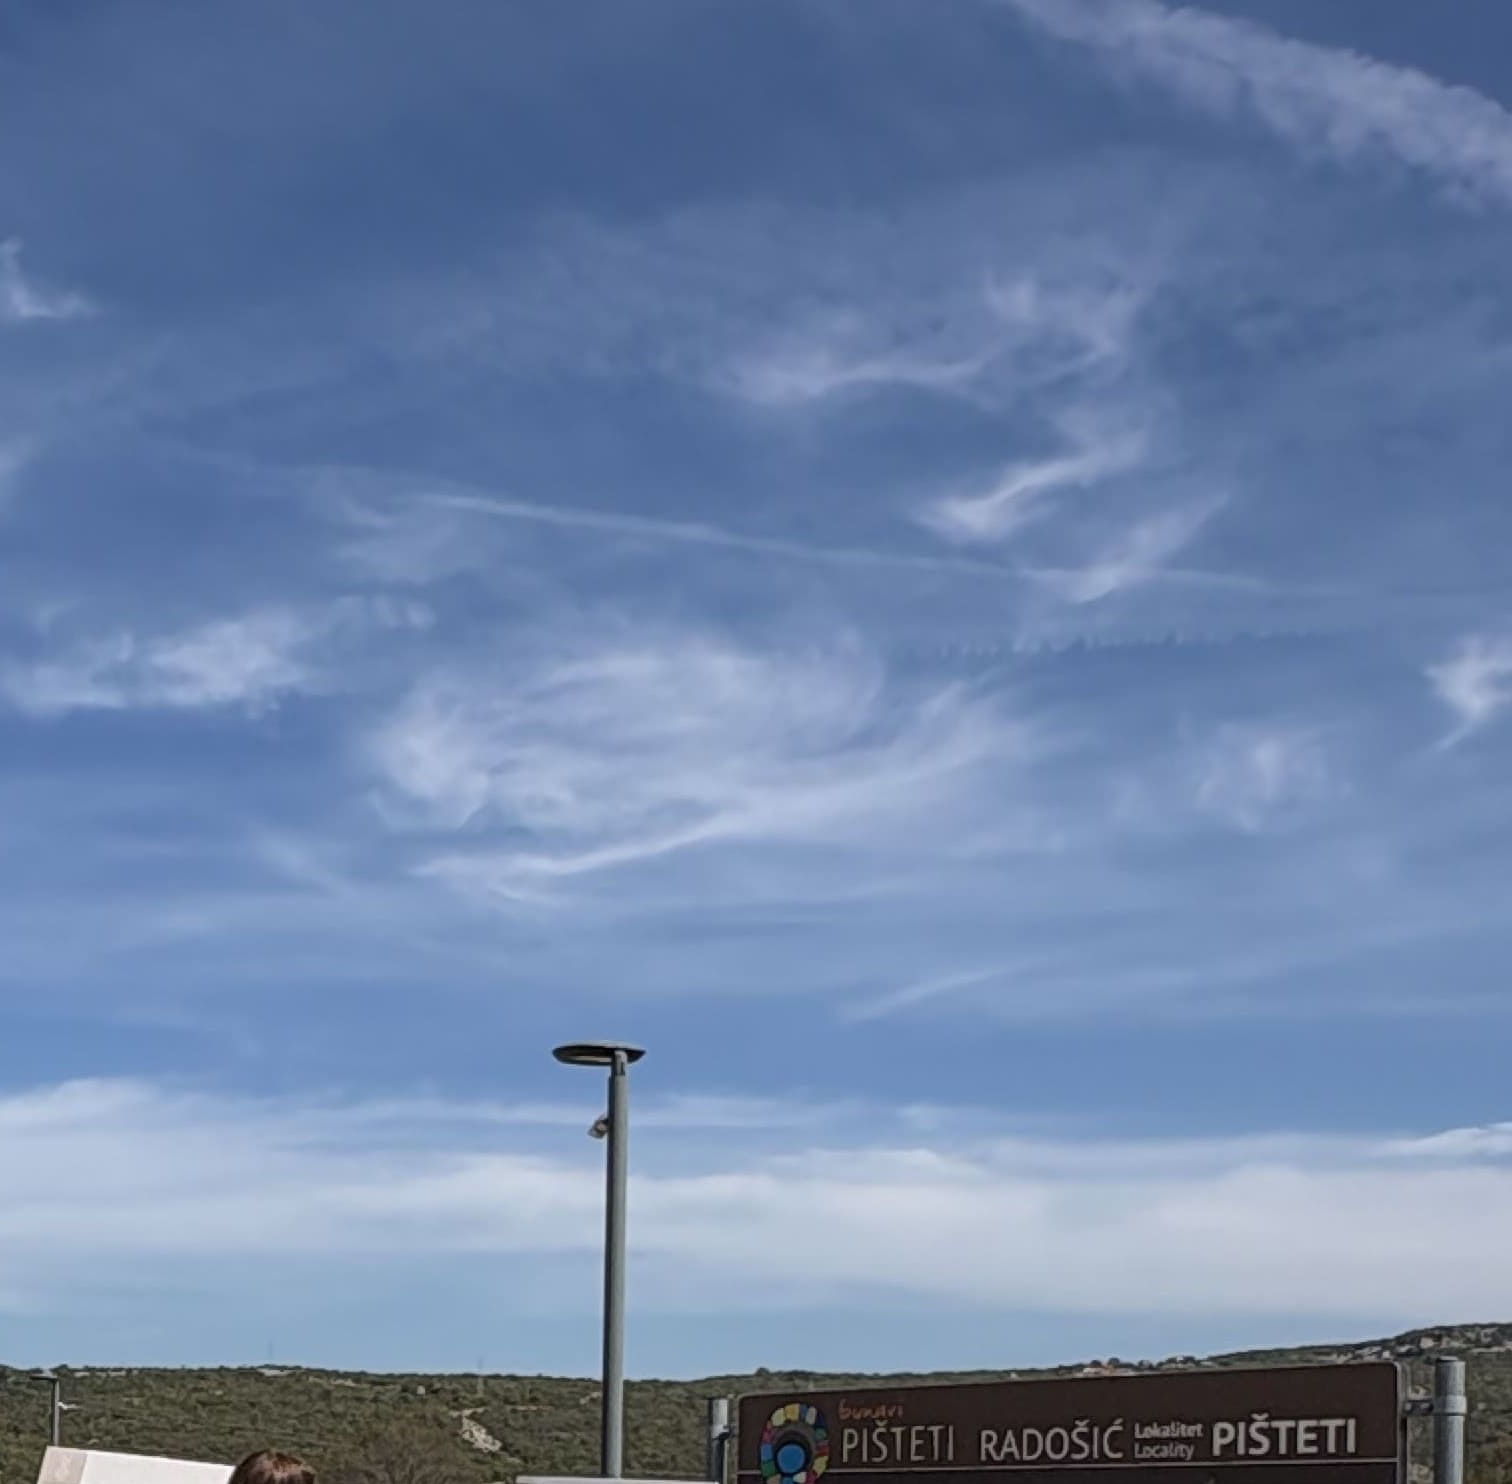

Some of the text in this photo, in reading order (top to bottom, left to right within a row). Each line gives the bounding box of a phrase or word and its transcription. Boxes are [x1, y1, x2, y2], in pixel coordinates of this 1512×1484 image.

[842, 1419, 954, 1463] PIŠTETI
[980, 1418, 1123, 1462] RADOŠIĆ
[1135, 1421, 1203, 1438] Lokalitet
[1135, 1442, 1194, 1460] Locality
[1212, 1412, 1356, 1456] PIŠTETI
